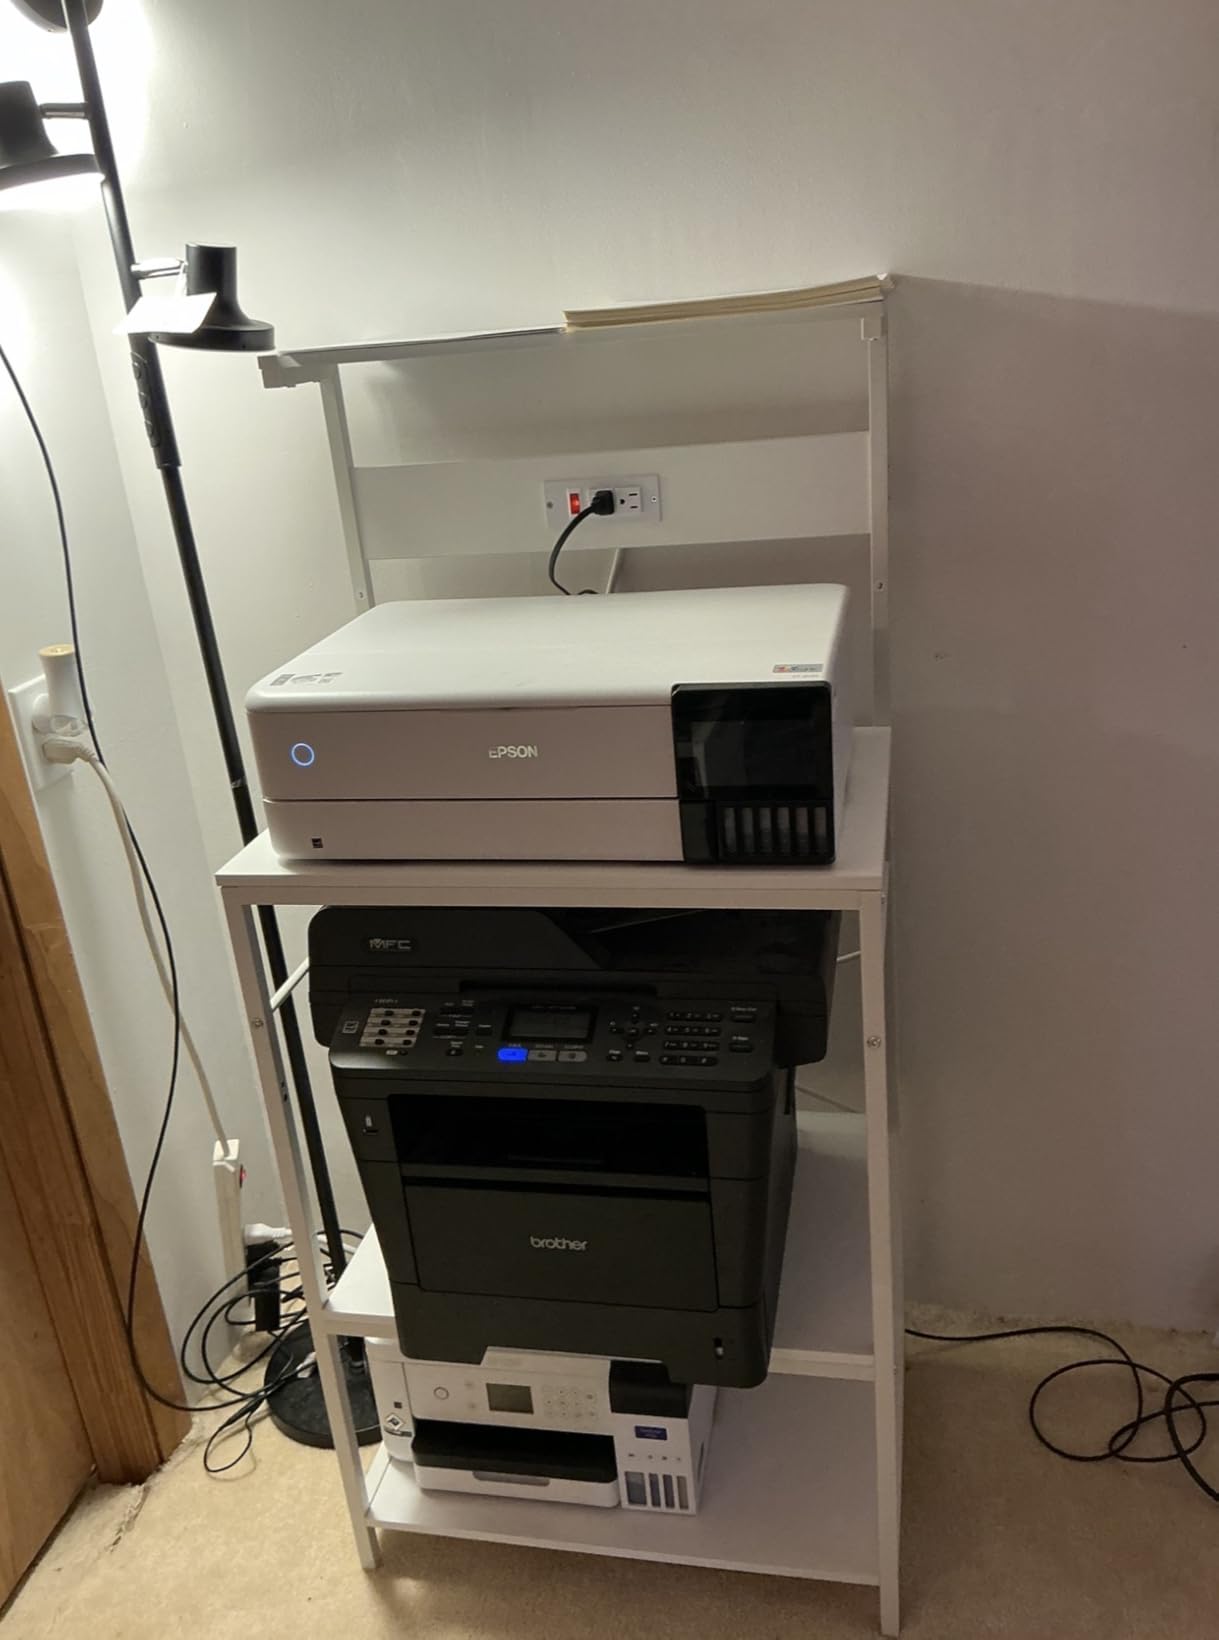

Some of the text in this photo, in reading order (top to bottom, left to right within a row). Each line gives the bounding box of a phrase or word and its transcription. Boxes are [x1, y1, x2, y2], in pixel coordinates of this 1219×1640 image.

[488, 745, 538, 759] EPSON
[369, 938, 411, 950] MFC
[530, 1236, 587, 1250] brother
